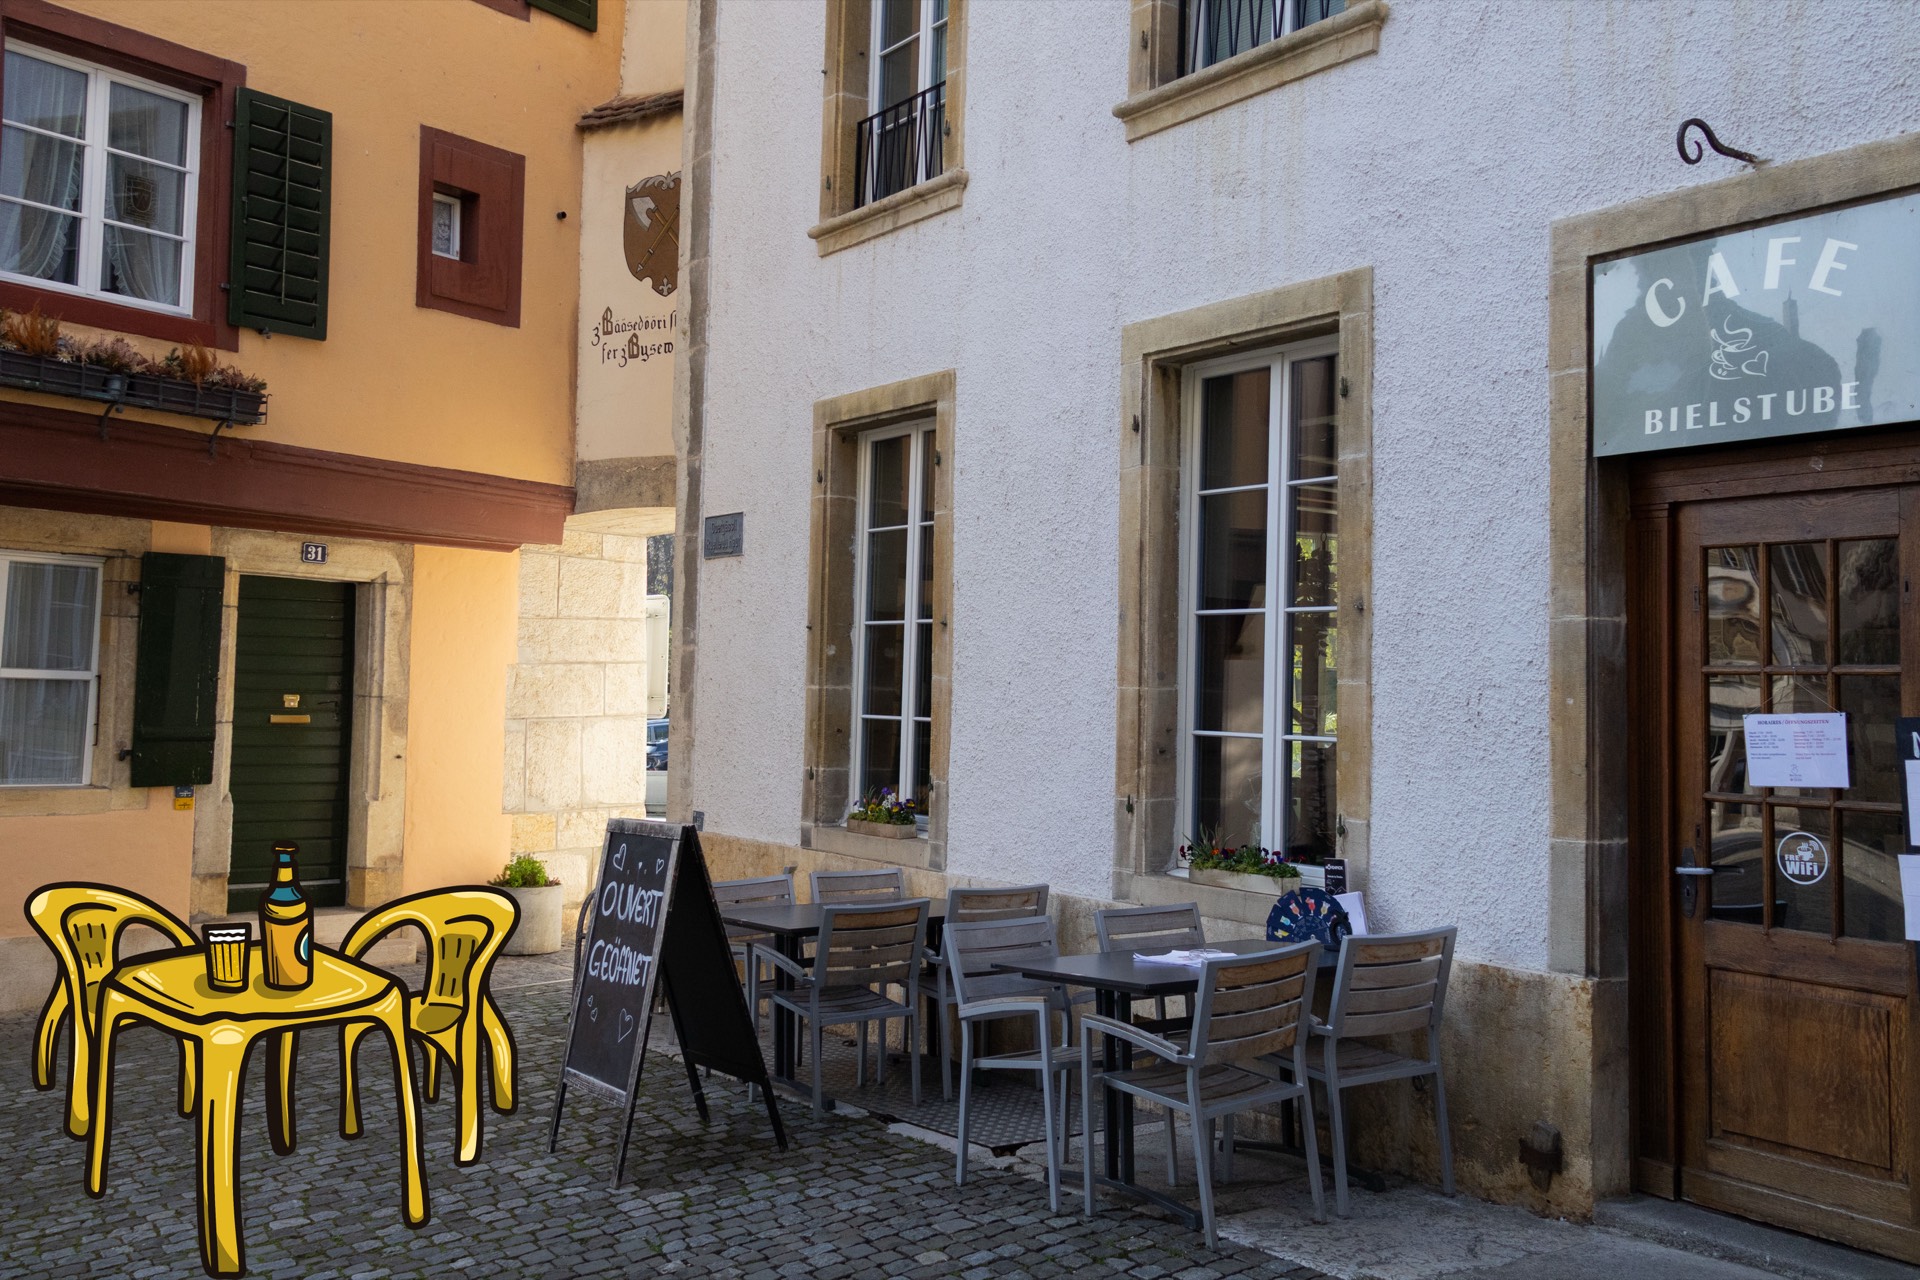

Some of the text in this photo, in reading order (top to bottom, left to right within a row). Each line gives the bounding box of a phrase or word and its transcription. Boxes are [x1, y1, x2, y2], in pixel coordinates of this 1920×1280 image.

[1645, 236, 1858, 328] CAFE
[1645, 381, 1861, 434] BIELSTUBE
[308, 545, 322, 561] 31
[1785, 861, 1819, 876] WiFi
[602, 881, 664, 928] OUVERT
